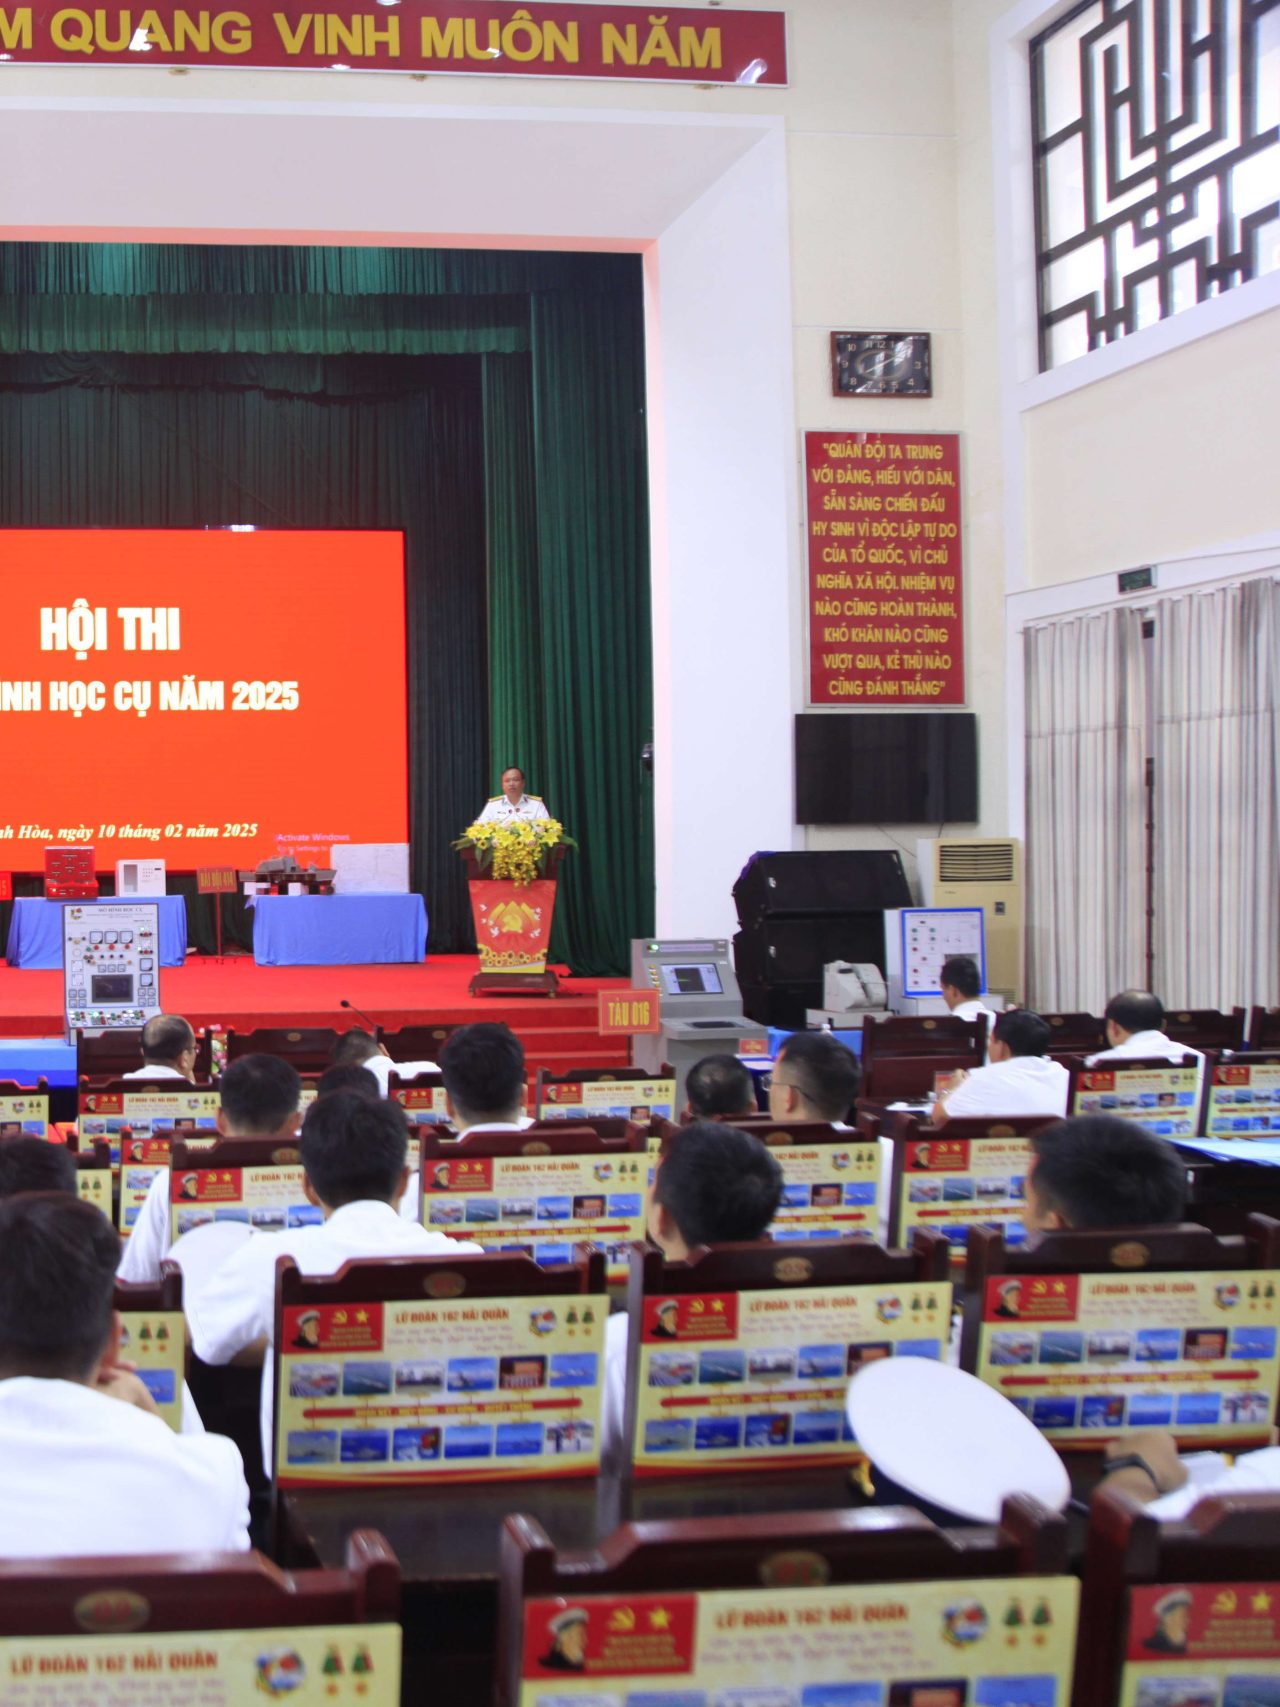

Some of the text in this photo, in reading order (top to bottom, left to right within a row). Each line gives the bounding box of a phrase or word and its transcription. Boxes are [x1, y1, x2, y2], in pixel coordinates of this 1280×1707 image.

[51, 9, 251, 53] QUANG
[275, 13, 400, 56] VINH
[422, 11, 578, 62] MUÔN
[603, 17, 720, 68] NĂM
[865, 441, 885, 462] ĐỘI
[889, 445, 902, 459] TA
[906, 445, 943, 460] TRUNG
[812, 464, 955, 487] VỚI ĐẢNG, HIẾU VỚI DÂN,
[812, 518, 957, 541] HY SINH VÌ ĐỘC LẬP TỰ DO
[823, 540, 948, 566] CỦA TỔ QUỐC, VÌ CHỦ
[816, 571, 955, 594] NGHĨA XÃ HỘI. NHIỆM VỤ
[816, 596, 957, 619] NÀO CŨNG HOÀN THÀNH,
[41, 599, 180, 660] HỘI THI
[824, 623, 948, 642] KHÓ KHĂN NÀO CŨNG
[50, 681, 105, 717] HỌC
[114, 681, 151, 717] CỤ
[160, 675, 224, 710] NĂM
[232, 681, 298, 710] 2025
[829, 677, 863, 695] CŨNG
[866, 676, 898, 695] ĐÁNH
[17, 824, 54, 842] Hòa,
[58, 827, 94, 843] ngày
[97, 823, 115, 839] 10
[119, 823, 160, 843] tháng
[164, 823, 182, 839] 02
[184, 823, 219, 839] năm
[222, 823, 258, 839] 2025
[276, 833, 350, 842] Activate Windows
[608, 996, 650, 1026] TÀU 016
[411, 1310, 438, 1322] ĐOÀN
[442, 1310, 458, 1322] 162
[482, 1308, 509, 1320] QUÂN
[39, 1653, 88, 1674] ĐOÀN
[96, 1654, 126, 1673] 162
[168, 1649, 218, 1671] QUÂN
